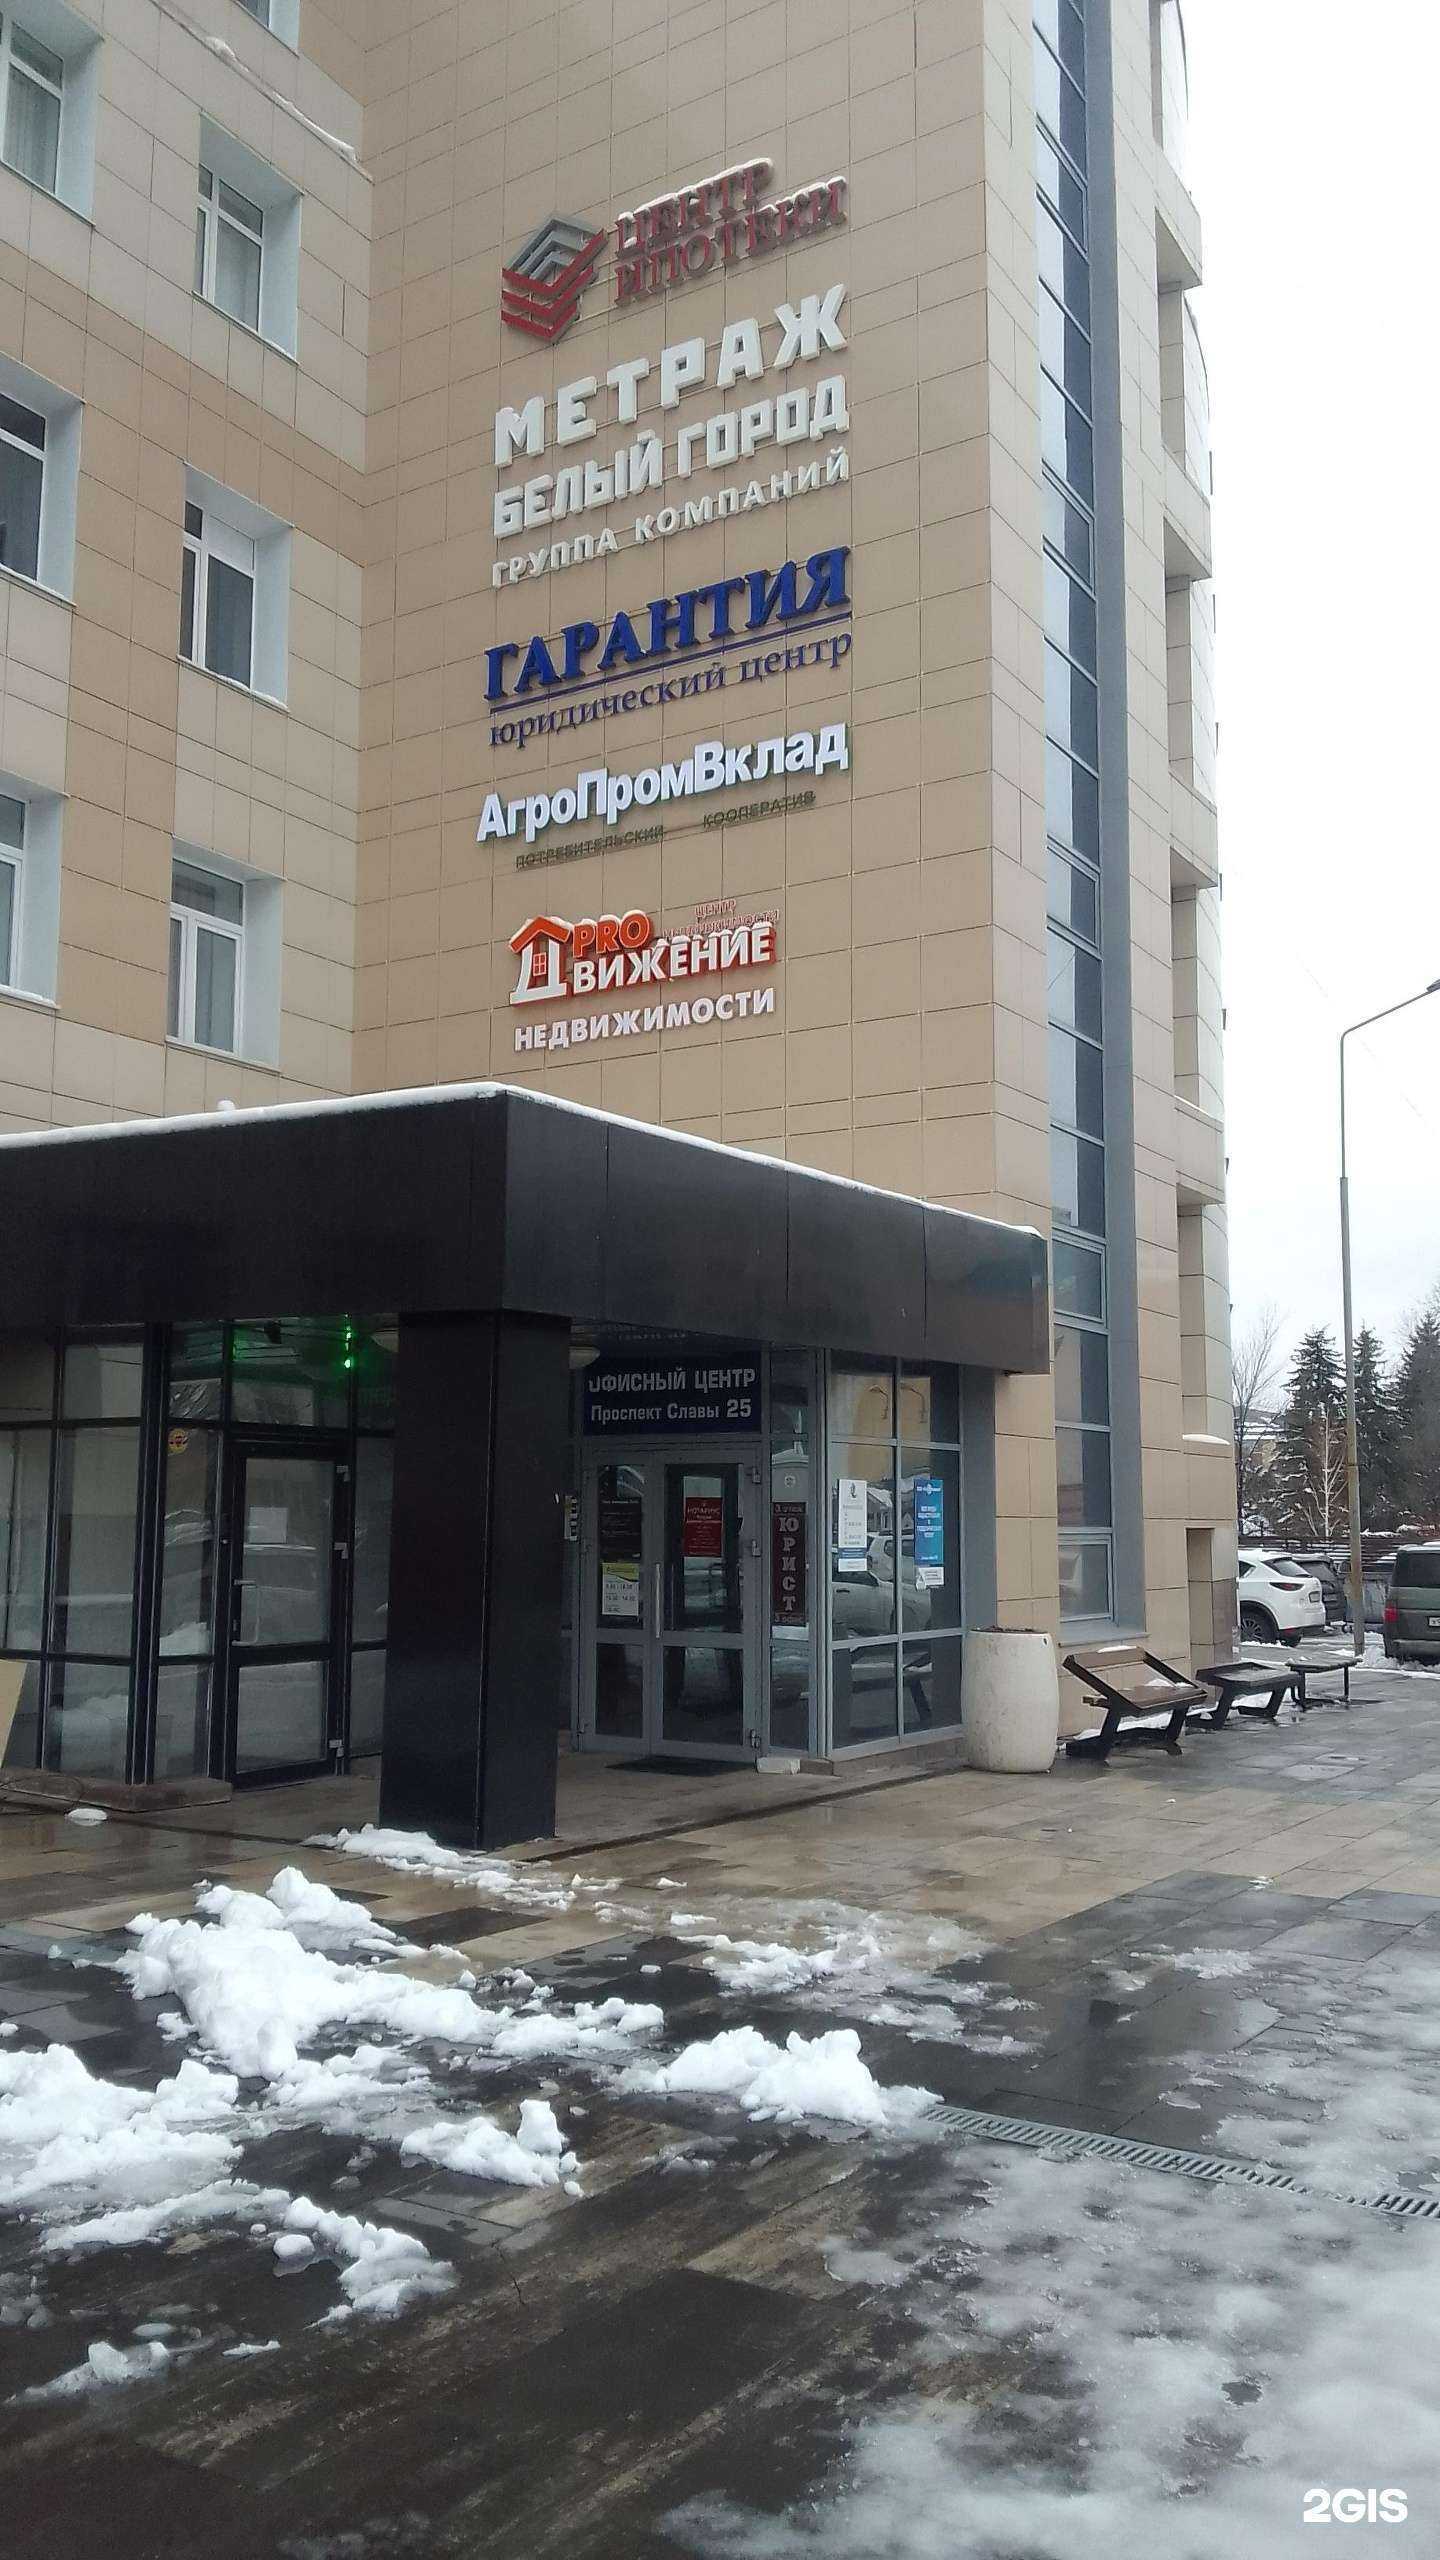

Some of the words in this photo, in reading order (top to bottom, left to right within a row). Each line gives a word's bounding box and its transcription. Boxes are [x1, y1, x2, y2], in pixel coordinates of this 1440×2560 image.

[495, 283, 848, 468] МЕТРАЖ
[493, 429, 663, 539] БЕЛЫЙ
[677, 374, 850, 478] ГОРОД
[492, 527, 620, 588] ГРУППА
[635, 446, 850, 543] КОМПАНИЙ
[484, 545, 851, 700] ГАРАНТИЯ
[488, 662, 727, 748] юридический
[740, 631, 852, 686] центр
[476, 722, 850, 844] АгроПромВклад
[703, 790, 817, 829] КООПЕРАТИВ
[572, 911, 650, 958] PRO
[515, 987, 775, 1052] НЕДВИЖИМОСТИ
[591, 1404, 662, 1425] Проспект
[667, 1402, 720, 1420] Славы
[726, 1398, 752, 1419] 25
[694, 1367, 756, 1394] ЦЕНТР
[778, 1516, 800, 1612] ЮРИСТ
